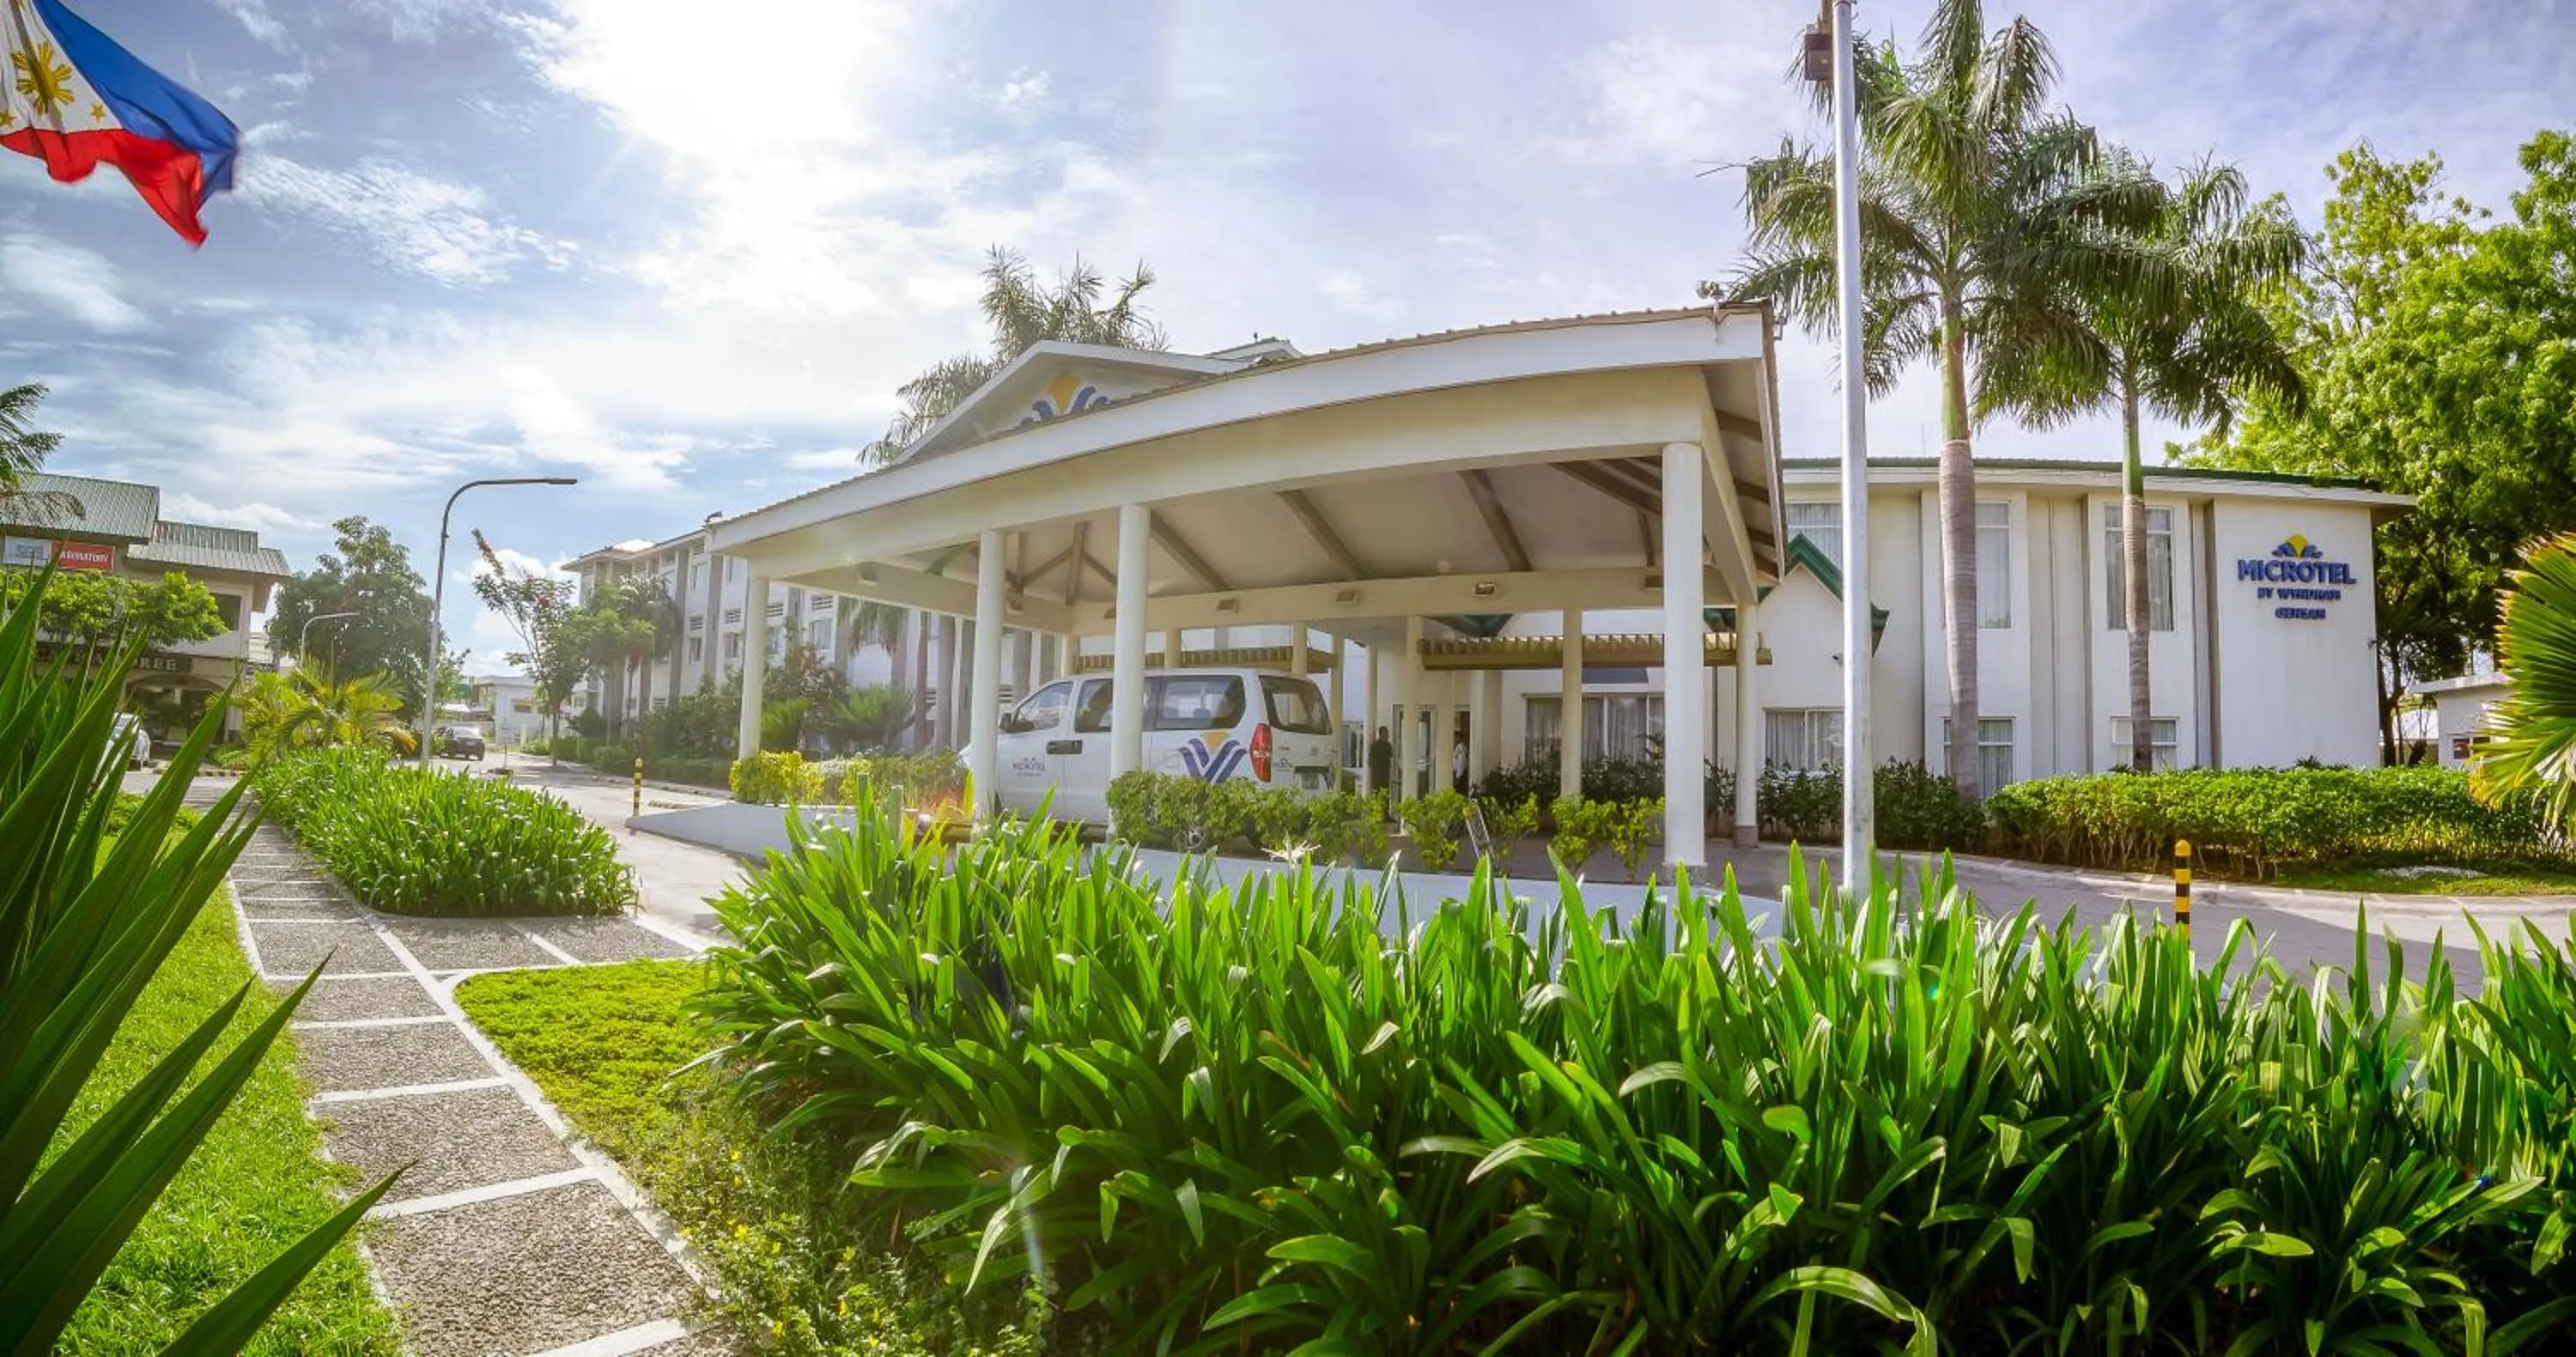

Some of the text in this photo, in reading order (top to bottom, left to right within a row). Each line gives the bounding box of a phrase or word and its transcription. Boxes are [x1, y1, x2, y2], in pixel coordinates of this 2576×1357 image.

[58, 551, 109, 563] ABORATORY
[2238, 560, 2357, 585] MICROTEL
[2257, 587, 2274, 599] BY
